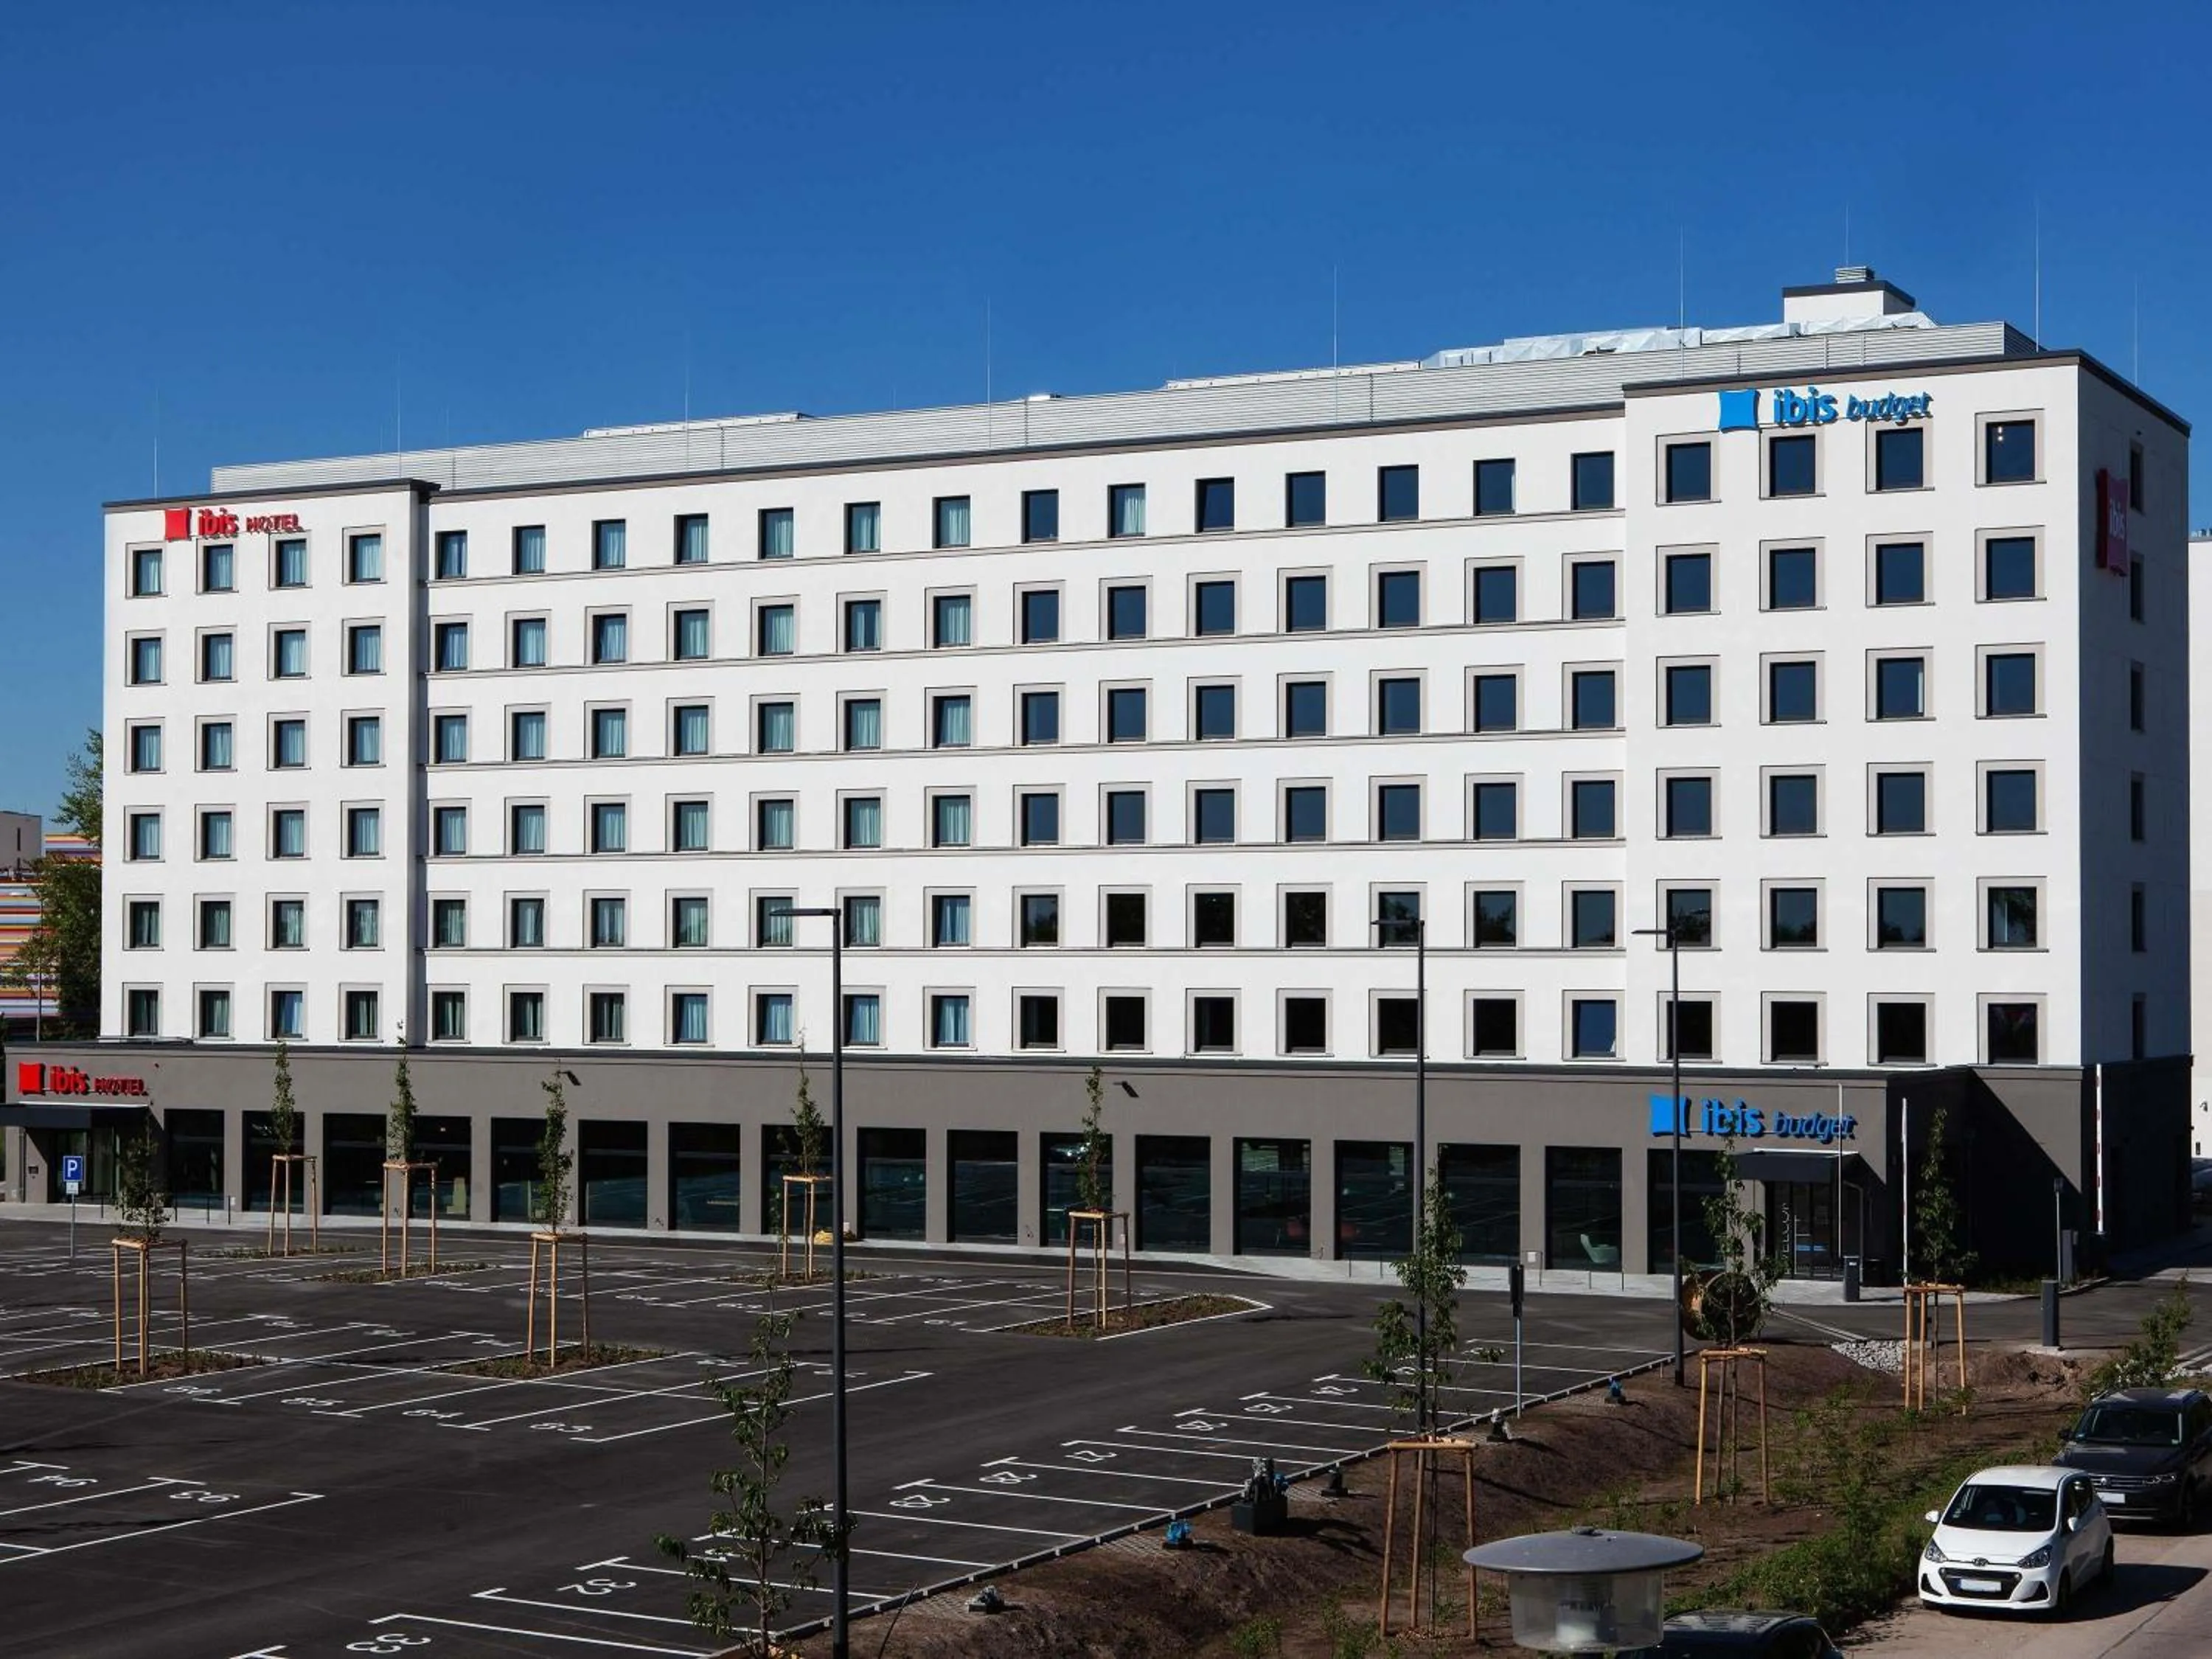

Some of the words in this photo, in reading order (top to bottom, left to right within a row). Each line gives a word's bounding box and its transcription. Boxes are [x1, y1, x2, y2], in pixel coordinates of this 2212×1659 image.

[1773, 386, 1838, 425] ibis
[1846, 391, 1933, 421] budget
[198, 507, 238, 535] ibis
[246, 514, 299, 532] HOTEL
[49, 1066, 88, 1093] ibis
[94, 1077, 145, 1093] HOTEL
[1700, 1097, 1763, 1135] ibis
[1773, 1110, 1856, 1142] budget
[67, 1159, 77, 1178] P
[556, 1578, 637, 1596] 32
[346, 1633, 431, 1654] 33
